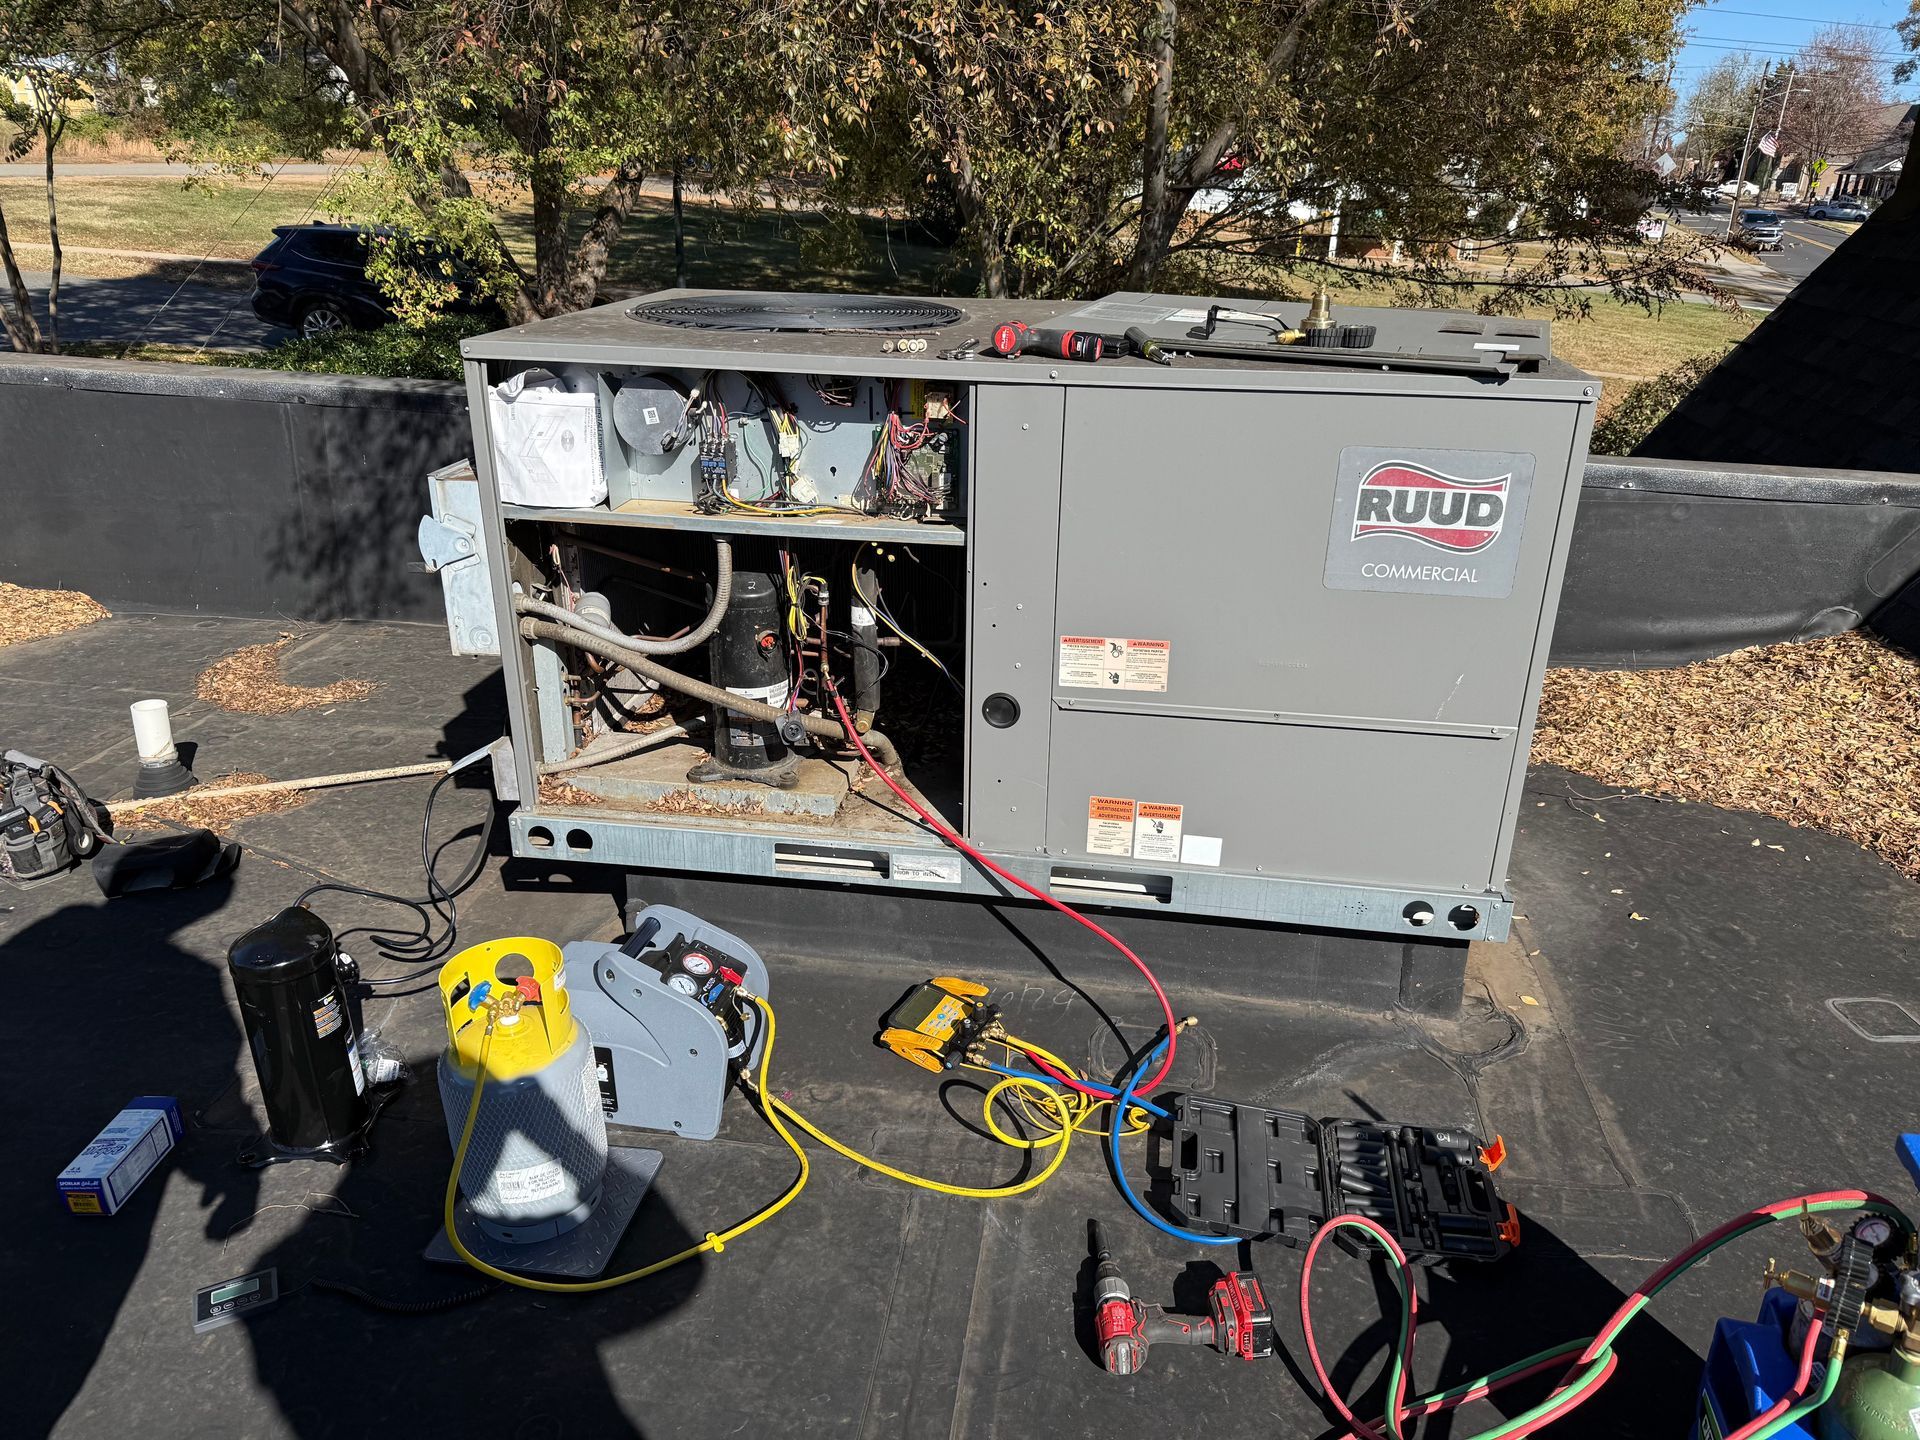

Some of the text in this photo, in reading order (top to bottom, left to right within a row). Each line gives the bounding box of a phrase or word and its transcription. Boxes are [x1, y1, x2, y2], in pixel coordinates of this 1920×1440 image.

[1357, 488, 1503, 527] RUUD
[1362, 563, 1478, 583] COMMERCIAL
[1143, 812, 1180, 820] AVERTISSEMENT
